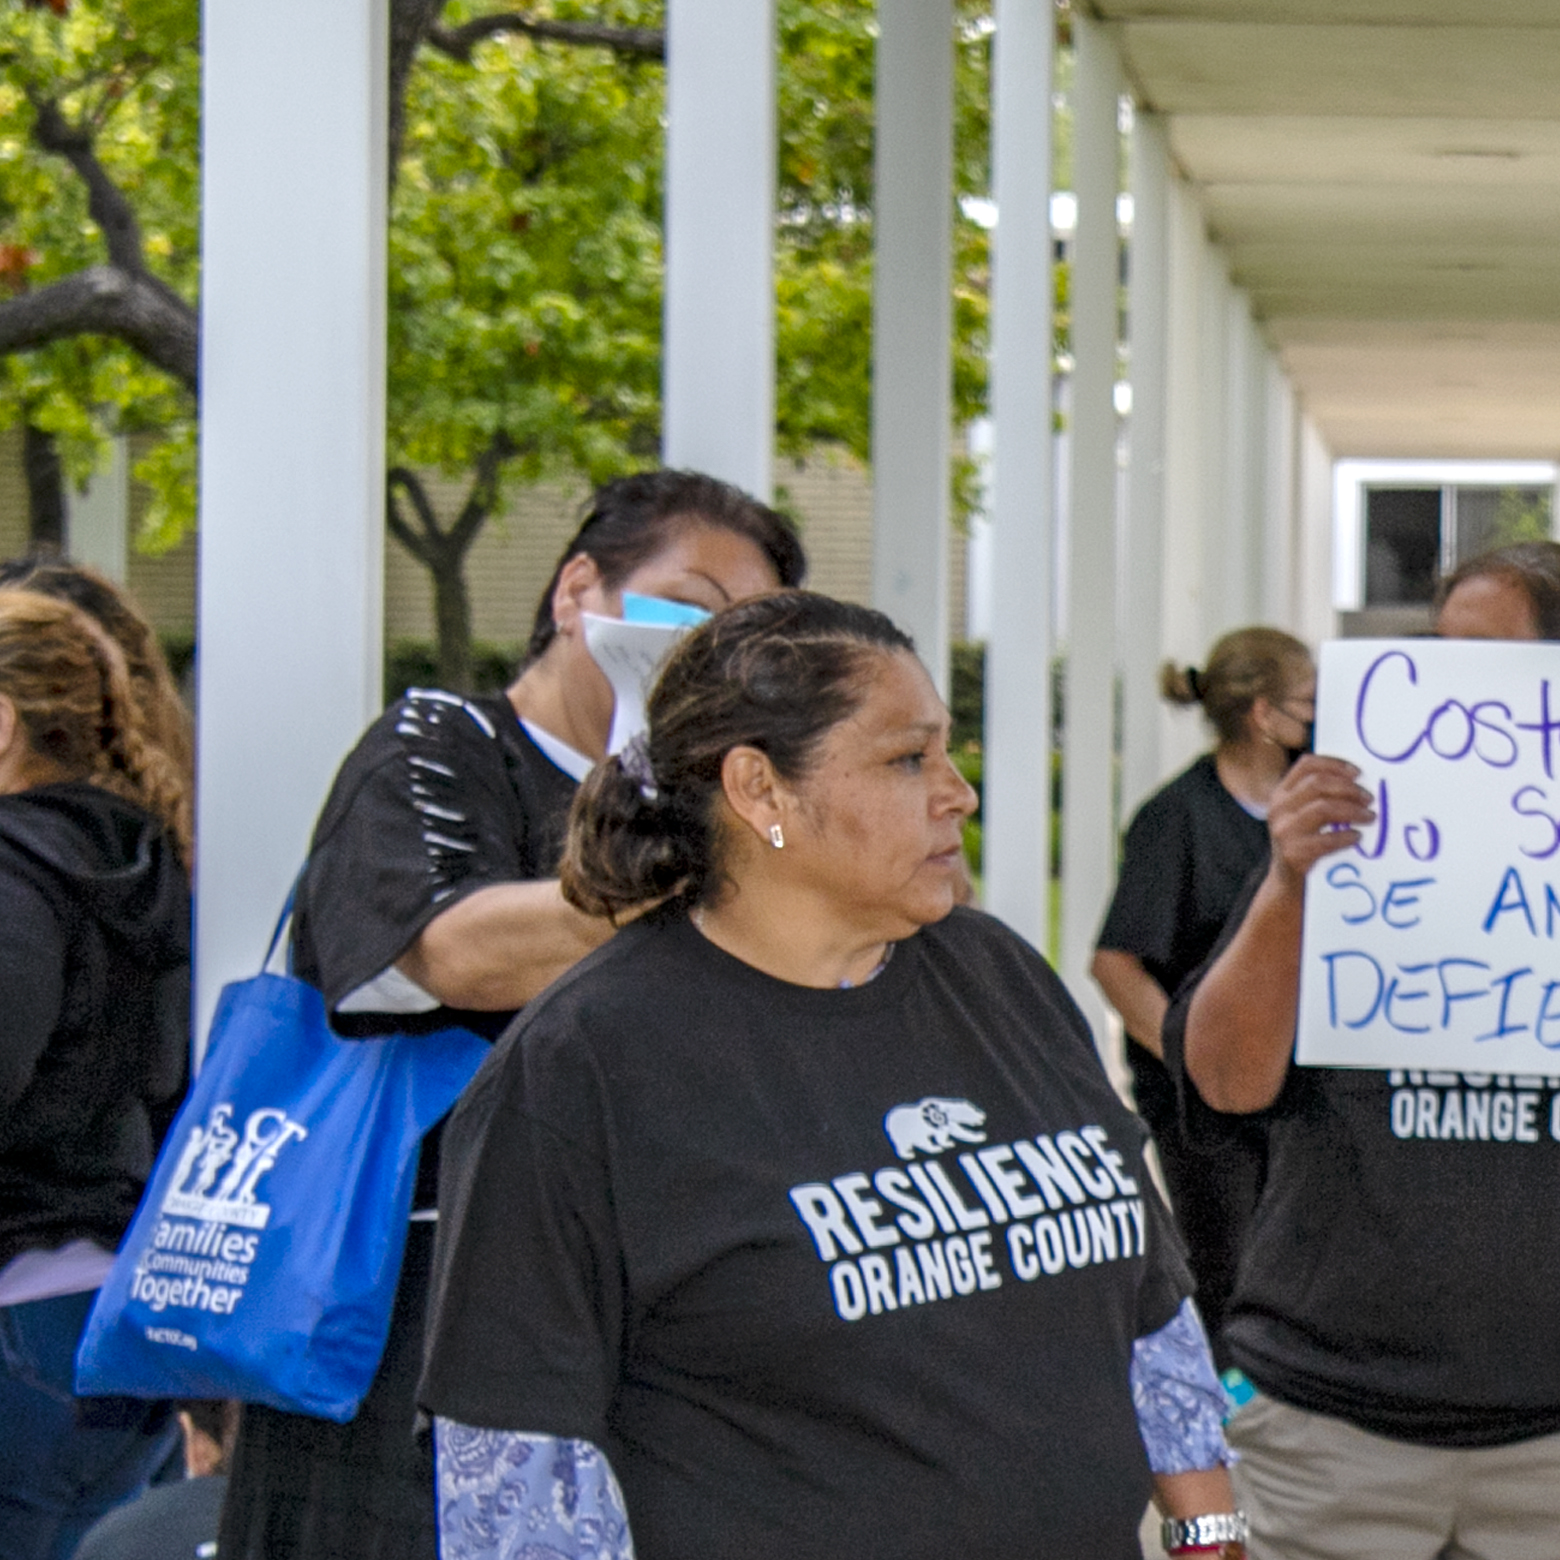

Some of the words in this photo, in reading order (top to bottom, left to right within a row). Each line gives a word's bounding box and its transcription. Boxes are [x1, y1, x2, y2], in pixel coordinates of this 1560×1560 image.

[1325, 861, 1438, 928] SE
[1390, 1086, 1541, 1143] ORANGE
[787, 1125, 1140, 1262] RESILIENCE
[131, 1265, 243, 1315] Together
[828, 1231, 1003, 1322] ORANGE
[1005, 1199, 1146, 1282] COUNTY
